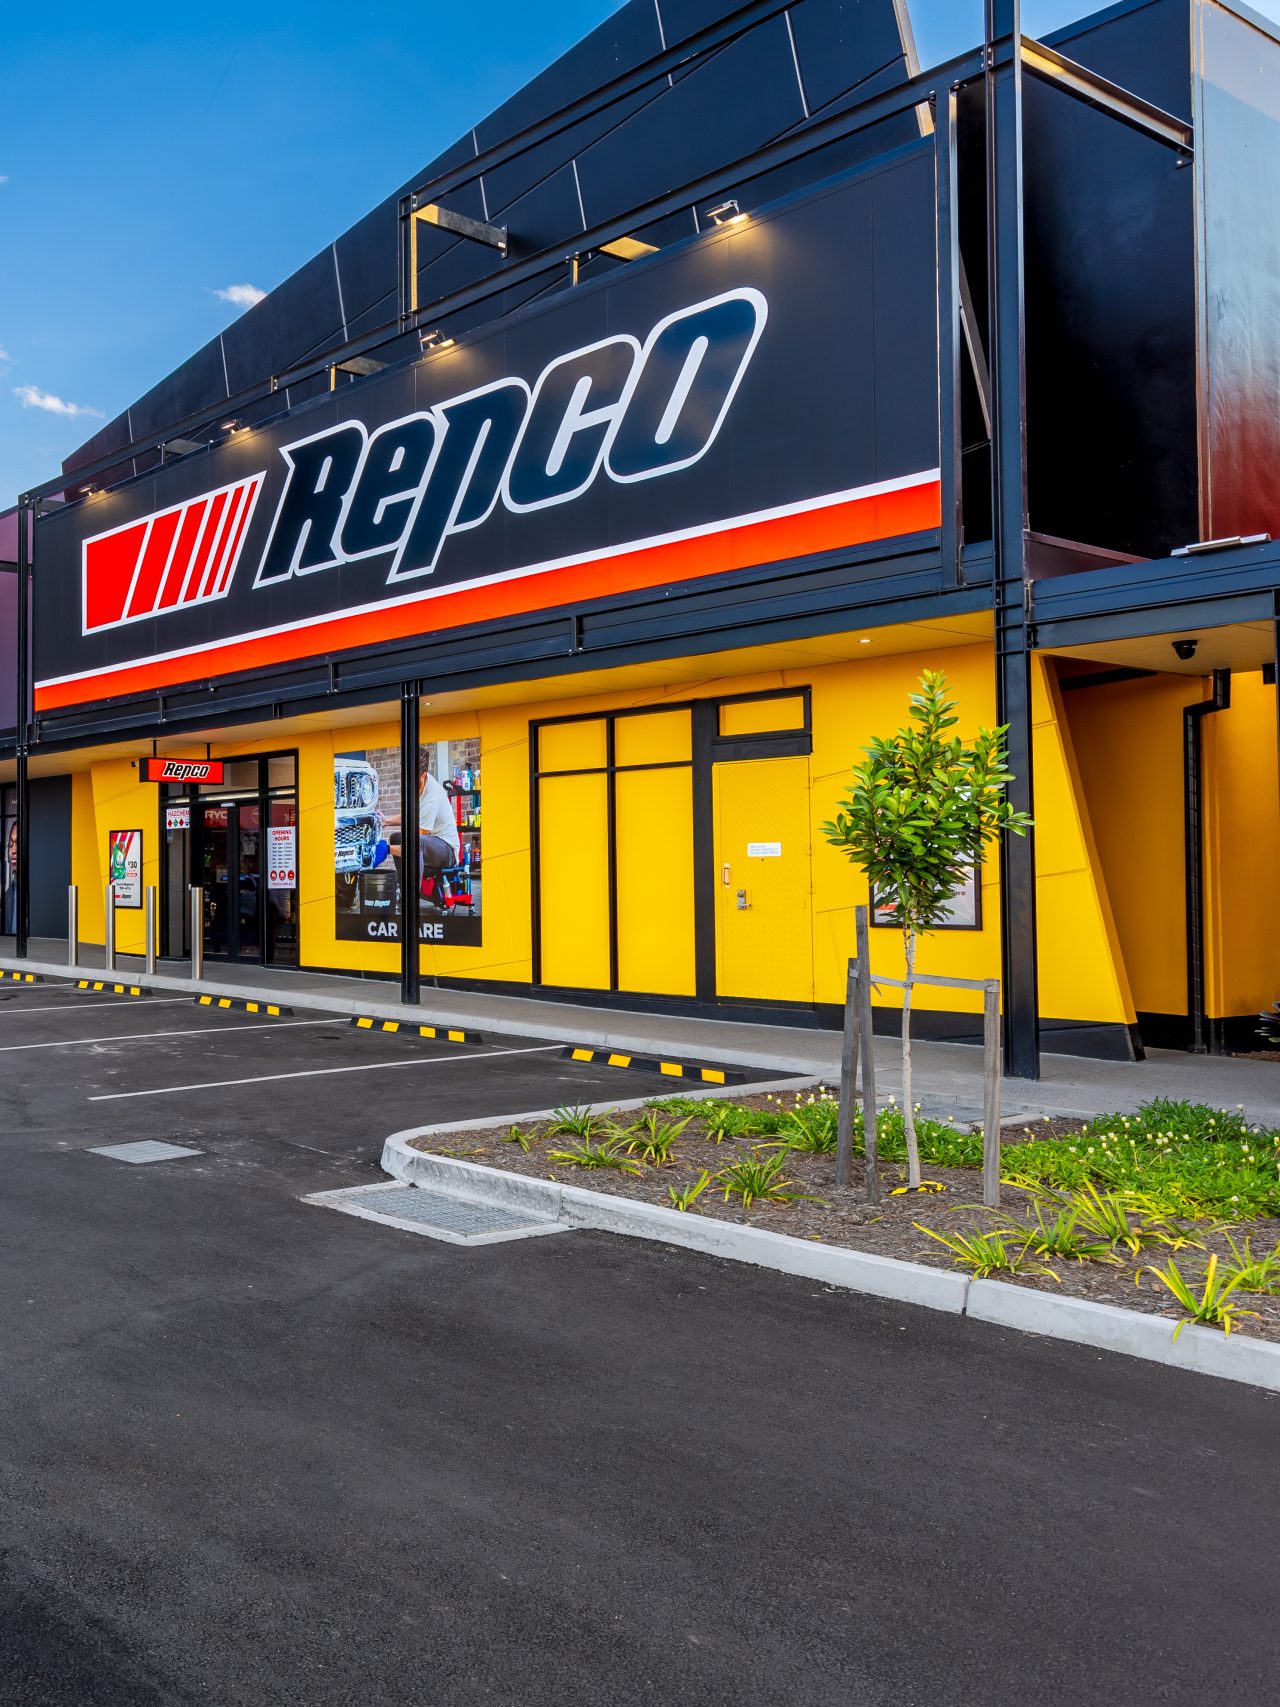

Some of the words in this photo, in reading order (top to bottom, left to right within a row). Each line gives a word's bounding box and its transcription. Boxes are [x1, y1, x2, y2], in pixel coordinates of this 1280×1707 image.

[252, 287, 768, 589] Repco
[162, 761, 210, 780] Repco
[367, 921, 398, 937] CAR
